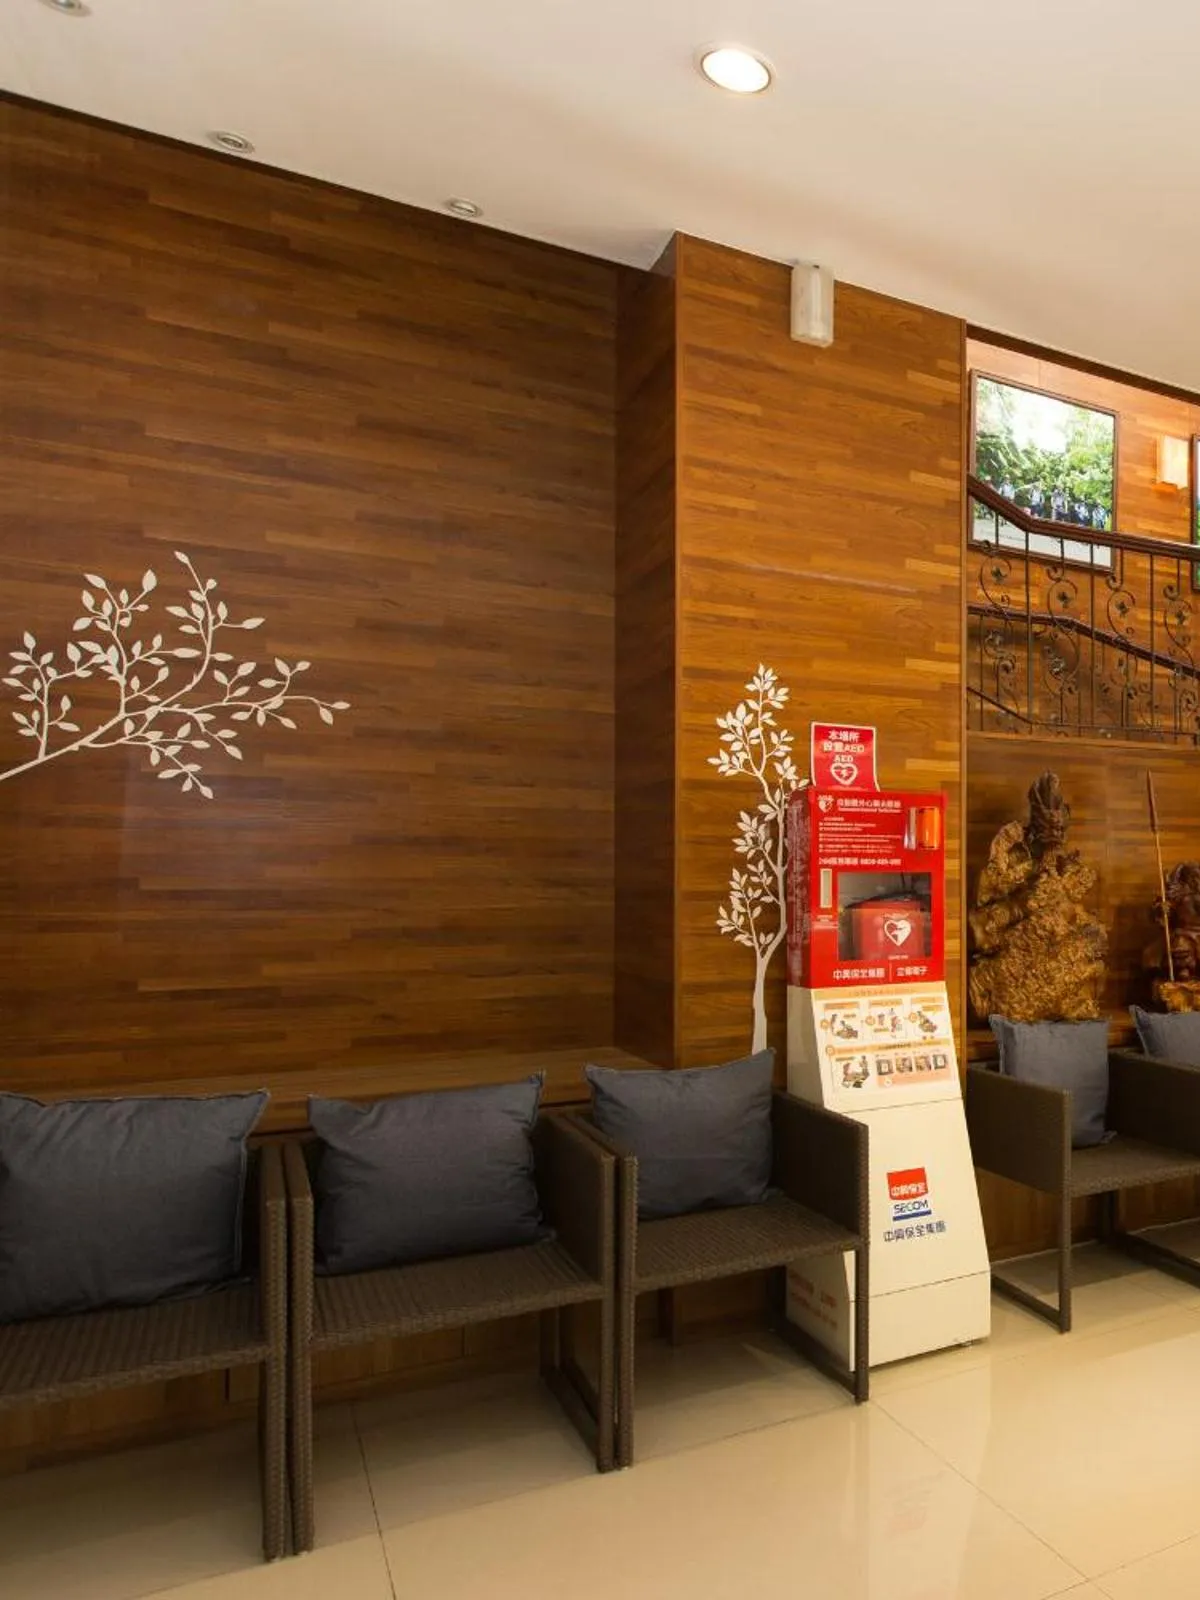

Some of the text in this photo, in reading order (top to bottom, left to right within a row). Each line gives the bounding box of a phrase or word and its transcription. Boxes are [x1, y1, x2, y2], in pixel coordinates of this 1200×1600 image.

[894, 1199, 929, 1214] SECOM
[883, 1220, 946, 1242] 中興保全集團
